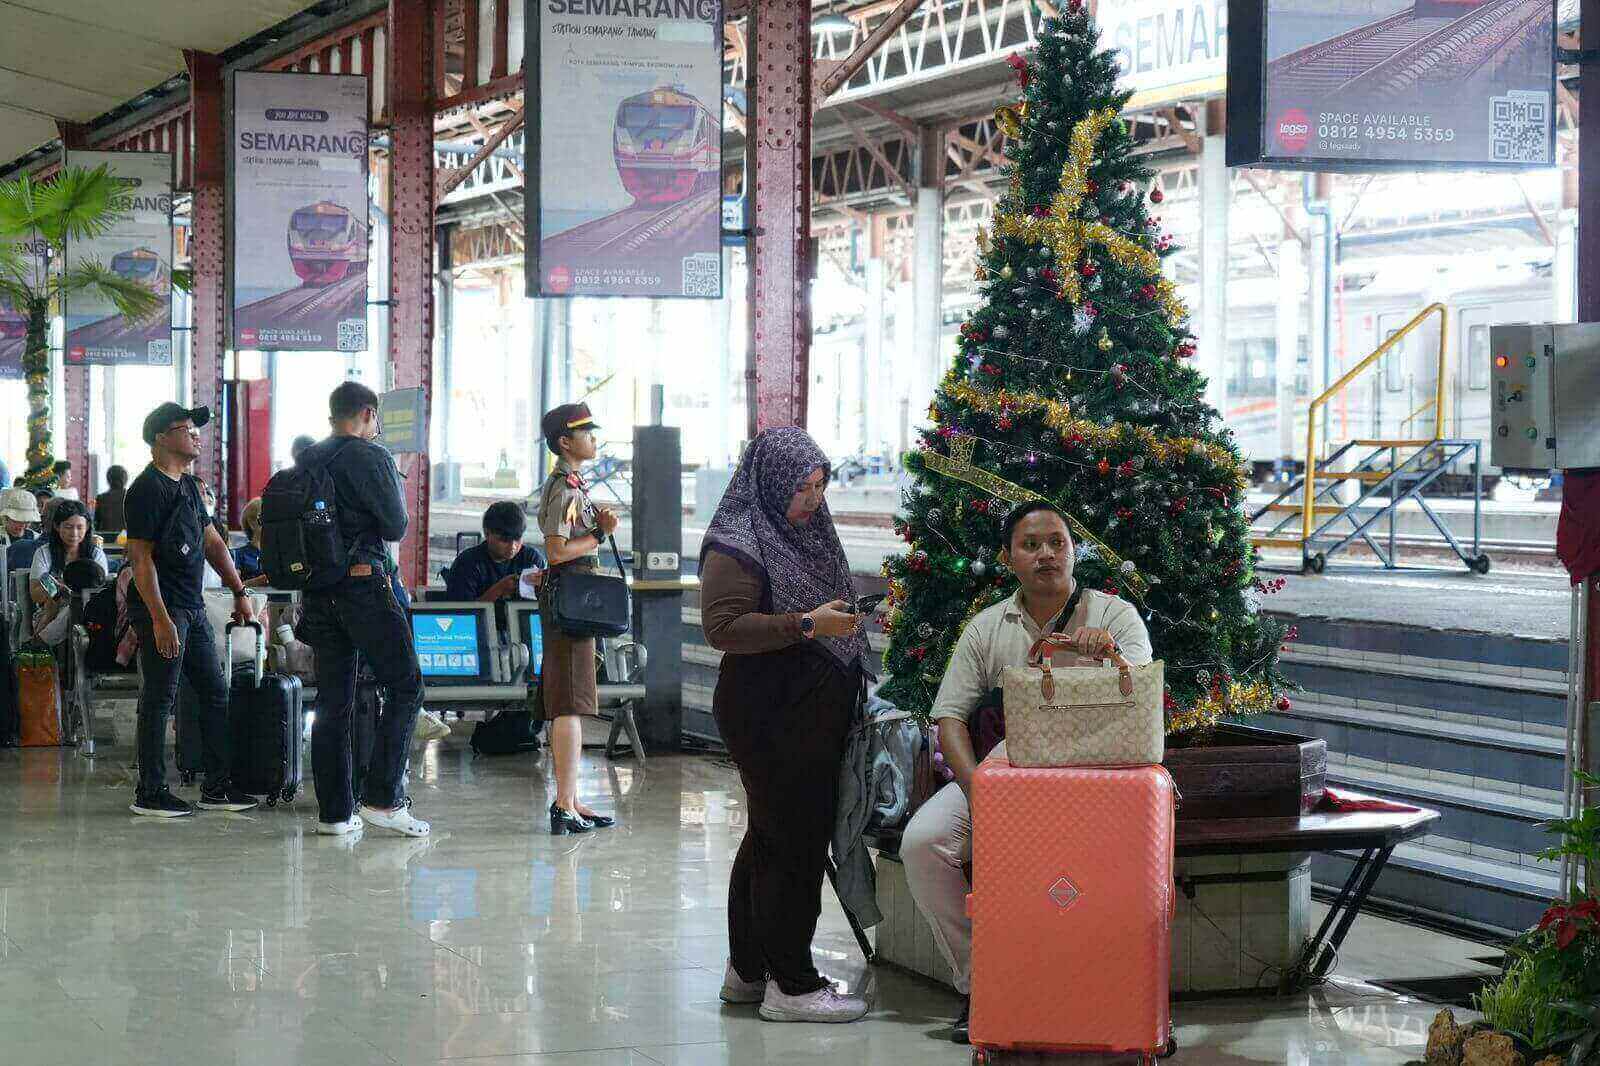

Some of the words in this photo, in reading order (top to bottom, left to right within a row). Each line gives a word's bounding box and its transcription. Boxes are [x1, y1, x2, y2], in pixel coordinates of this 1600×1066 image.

[1319, 112, 1358, 124] SPACE
[1362, 114, 1431, 127] AVAILABLE
[1318, 125, 1358, 138] 0812
[1364, 126, 1408, 140] 4954
[1414, 128, 1455, 142] 5359
[240, 132, 364, 154] SEMARANG
[575, 276, 600, 284] 0812
